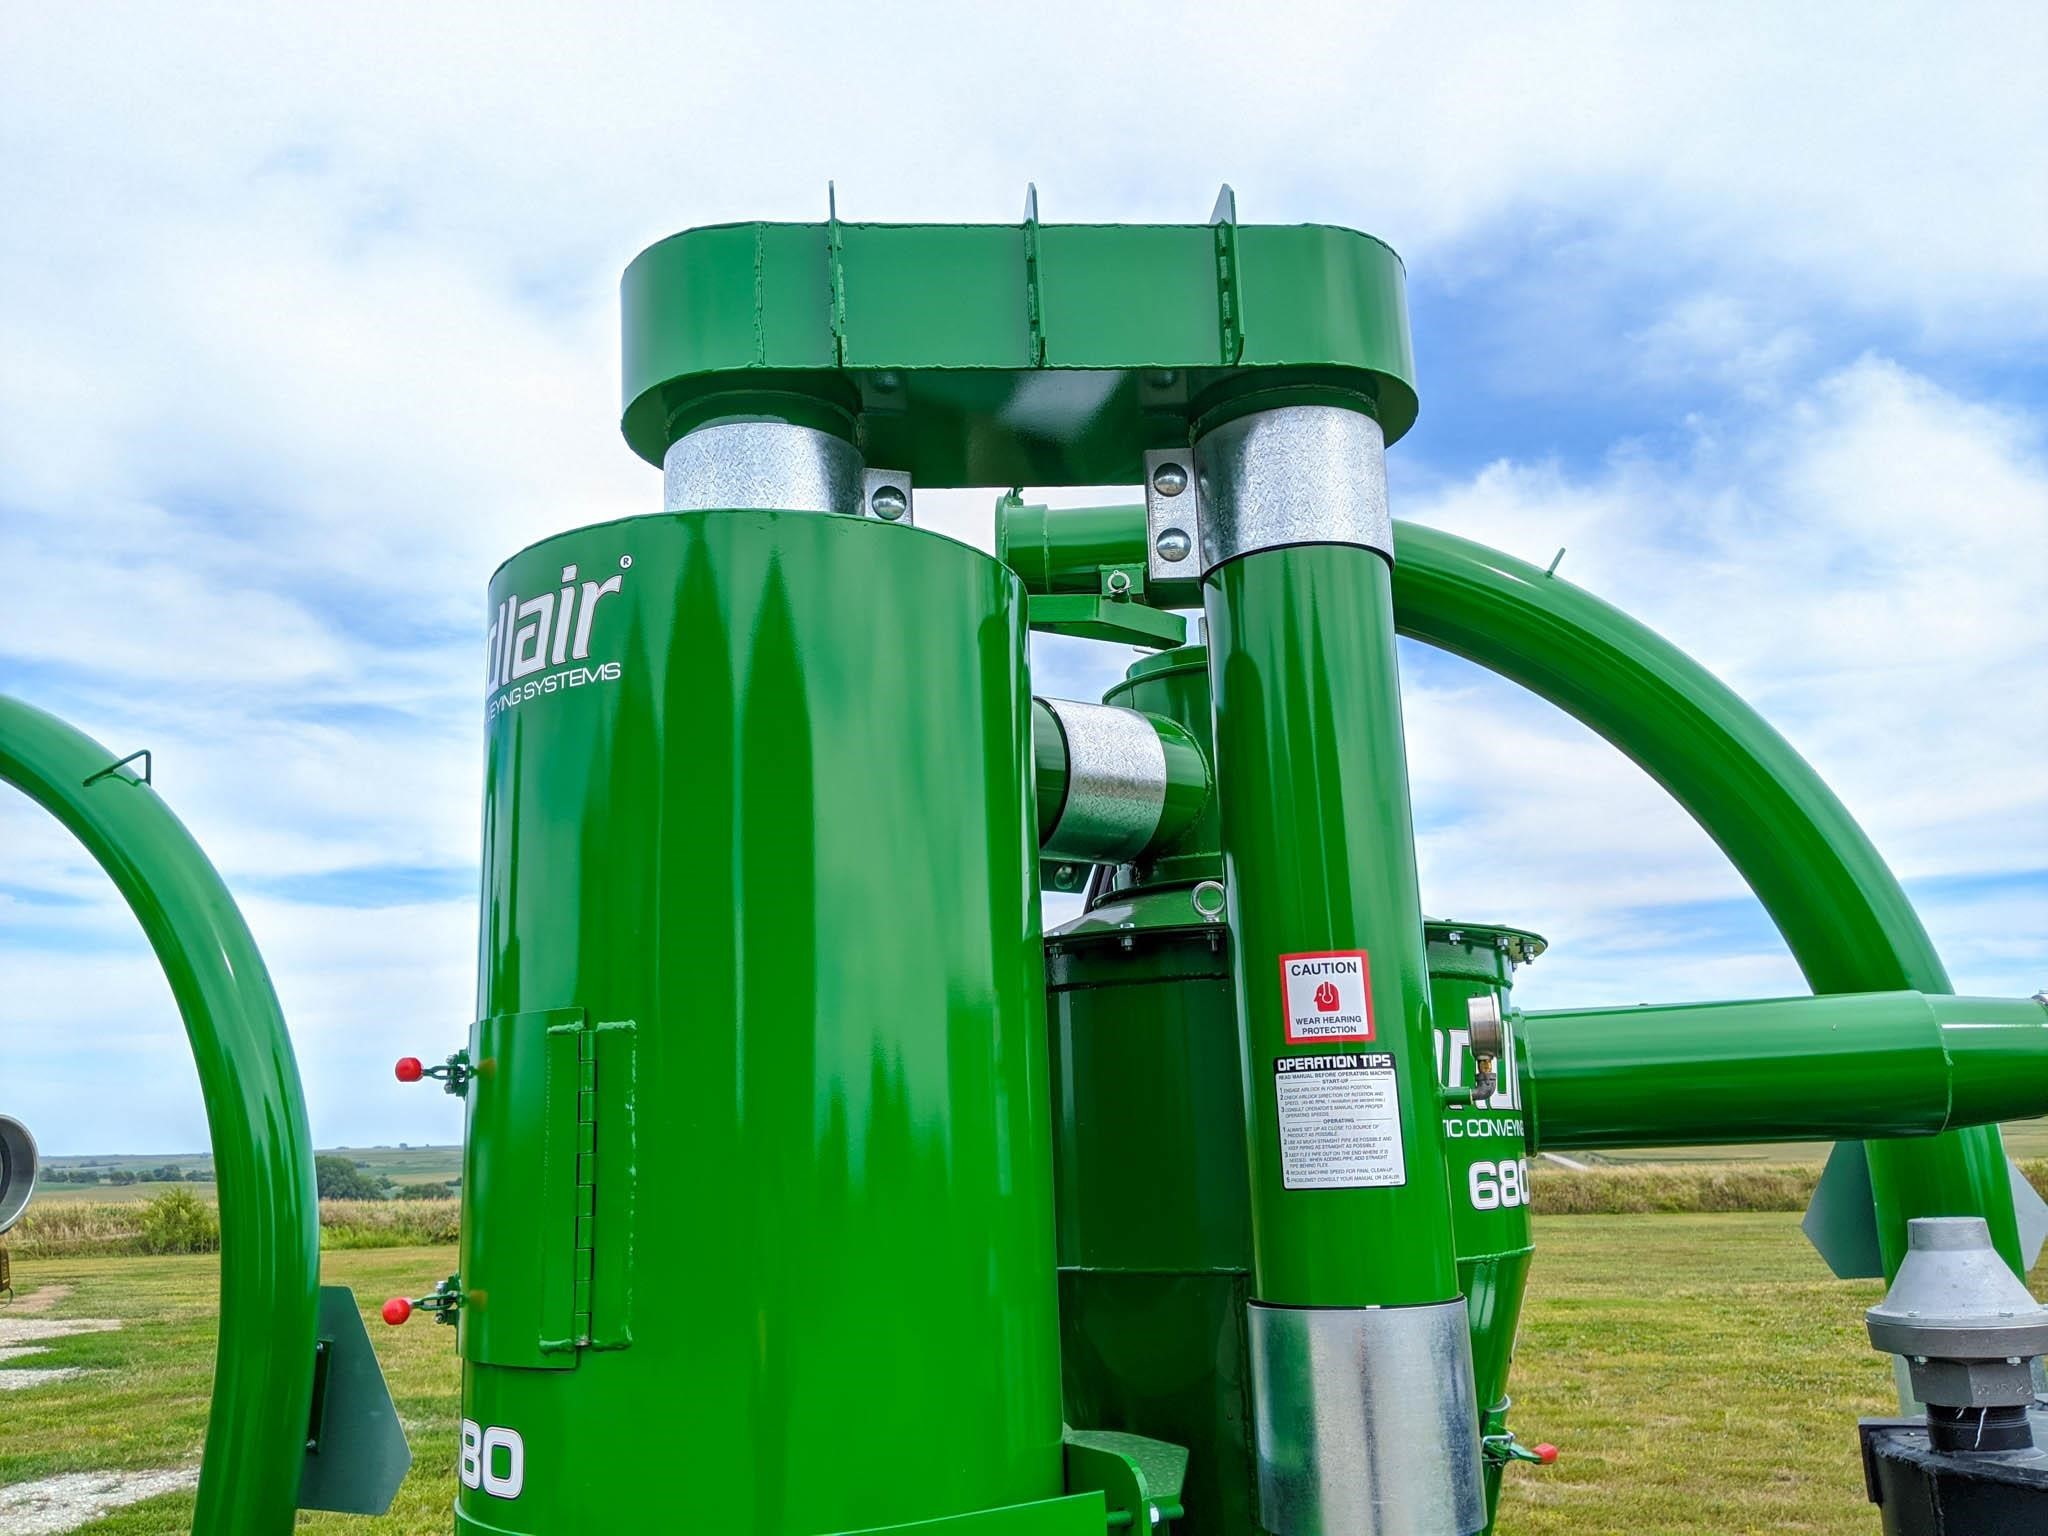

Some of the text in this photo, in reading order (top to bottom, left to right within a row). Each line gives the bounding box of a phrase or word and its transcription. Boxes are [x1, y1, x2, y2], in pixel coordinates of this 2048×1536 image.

[523, 662, 621, 700] SYSTEMS
[1291, 961, 1357, 976] CAUTION
[1296, 1015, 1362, 1025] WEAR HEARING
[1302, 1025, 1357, 1035] PROTECTION
[1277, 1054, 1392, 1072] OPERATION TIPS
[1468, 1158, 1530, 1210] 680
[462, 1417, 524, 1499] 80
